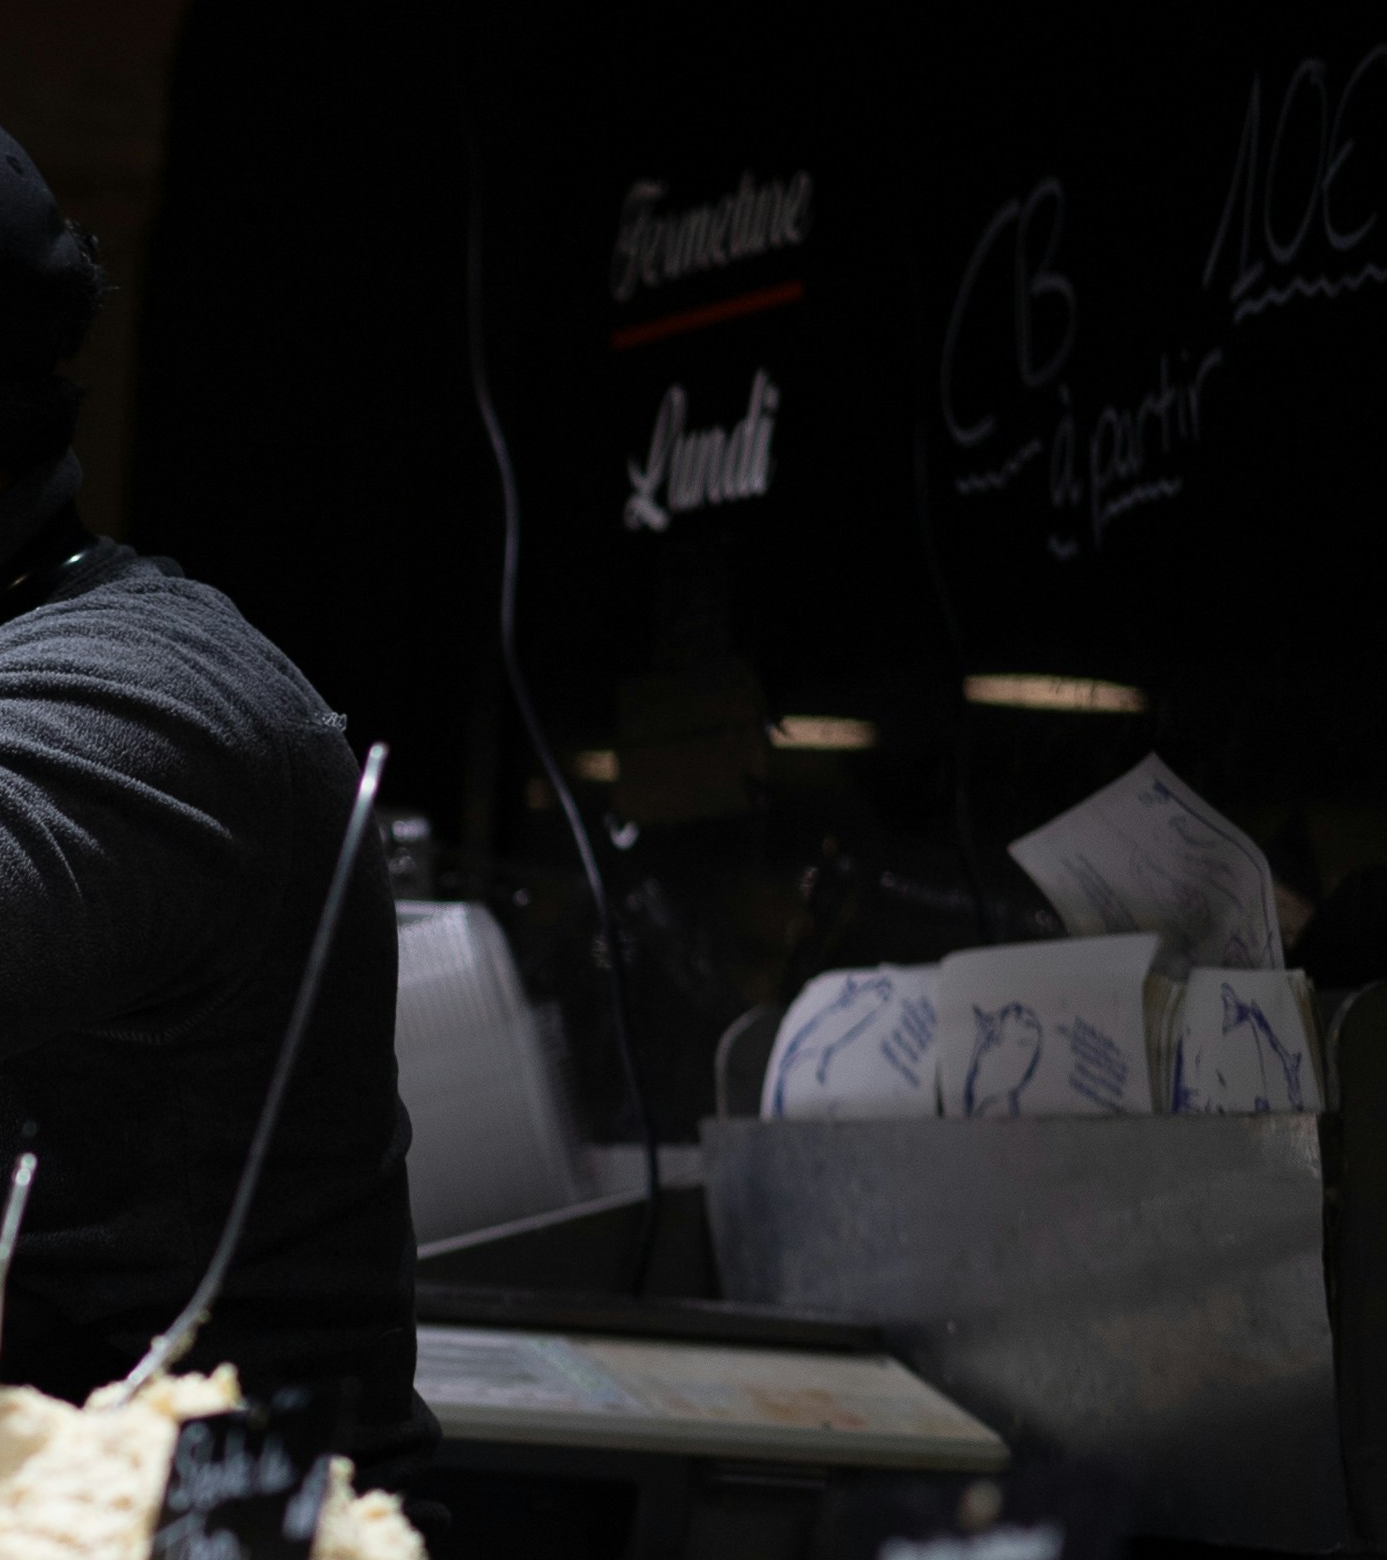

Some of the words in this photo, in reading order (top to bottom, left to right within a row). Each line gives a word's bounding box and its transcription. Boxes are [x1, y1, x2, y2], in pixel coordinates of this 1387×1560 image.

[610, 168, 815, 305] Fermeture
[941, 174, 1079, 446] CB
[624, 365, 783, 532] Lundi
[1089, 345, 1227, 550] partir
